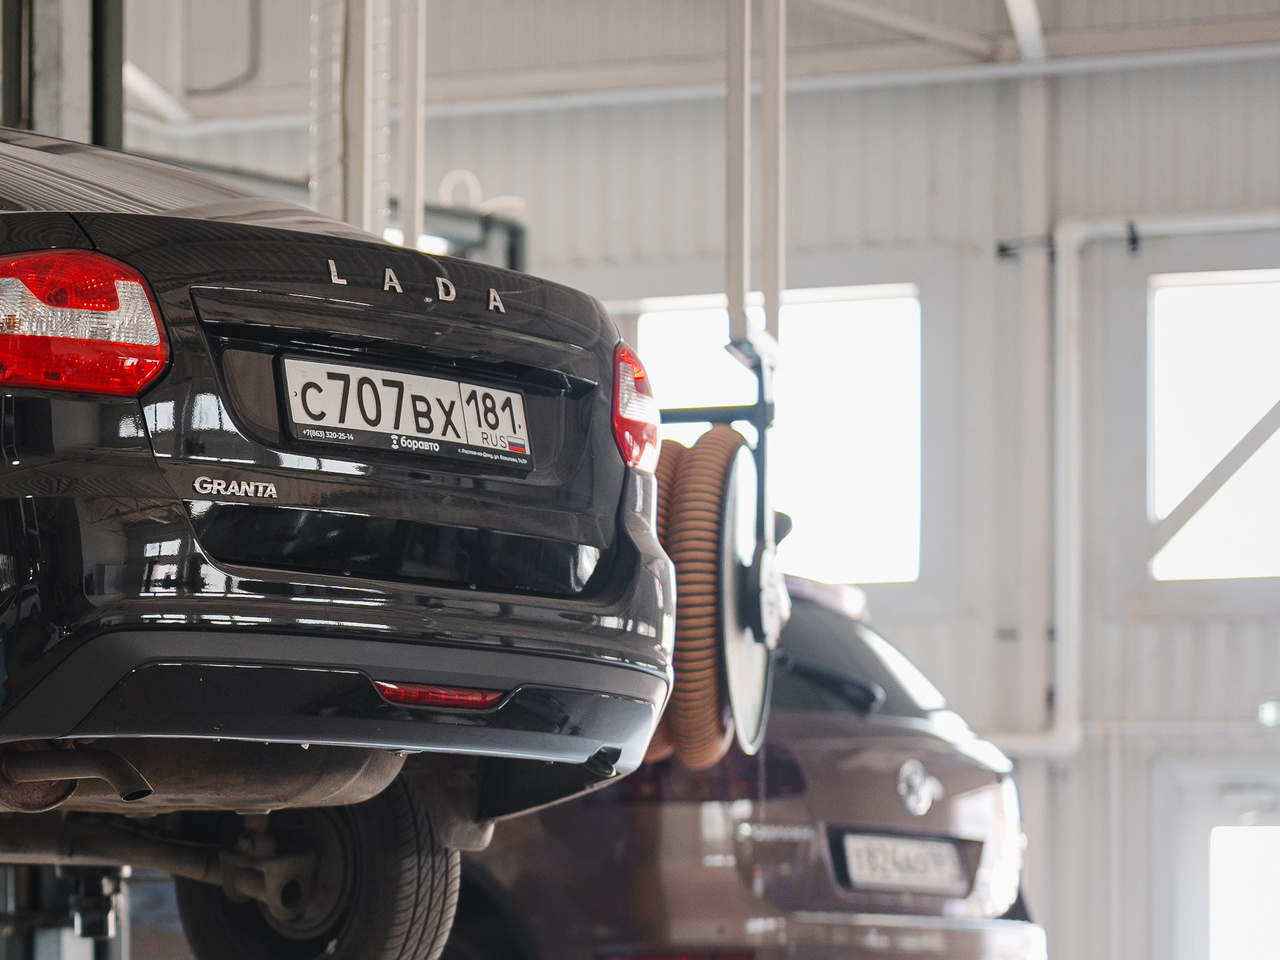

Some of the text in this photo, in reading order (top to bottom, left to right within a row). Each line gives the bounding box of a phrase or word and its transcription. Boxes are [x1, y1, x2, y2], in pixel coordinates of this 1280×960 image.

[328, 259, 506, 313] LADA
[465, 389, 518, 435] 181
[400, 436, 440, 452] боравто
[481, 431, 507, 449] RUS
[193, 476, 278, 498] GRANTA
